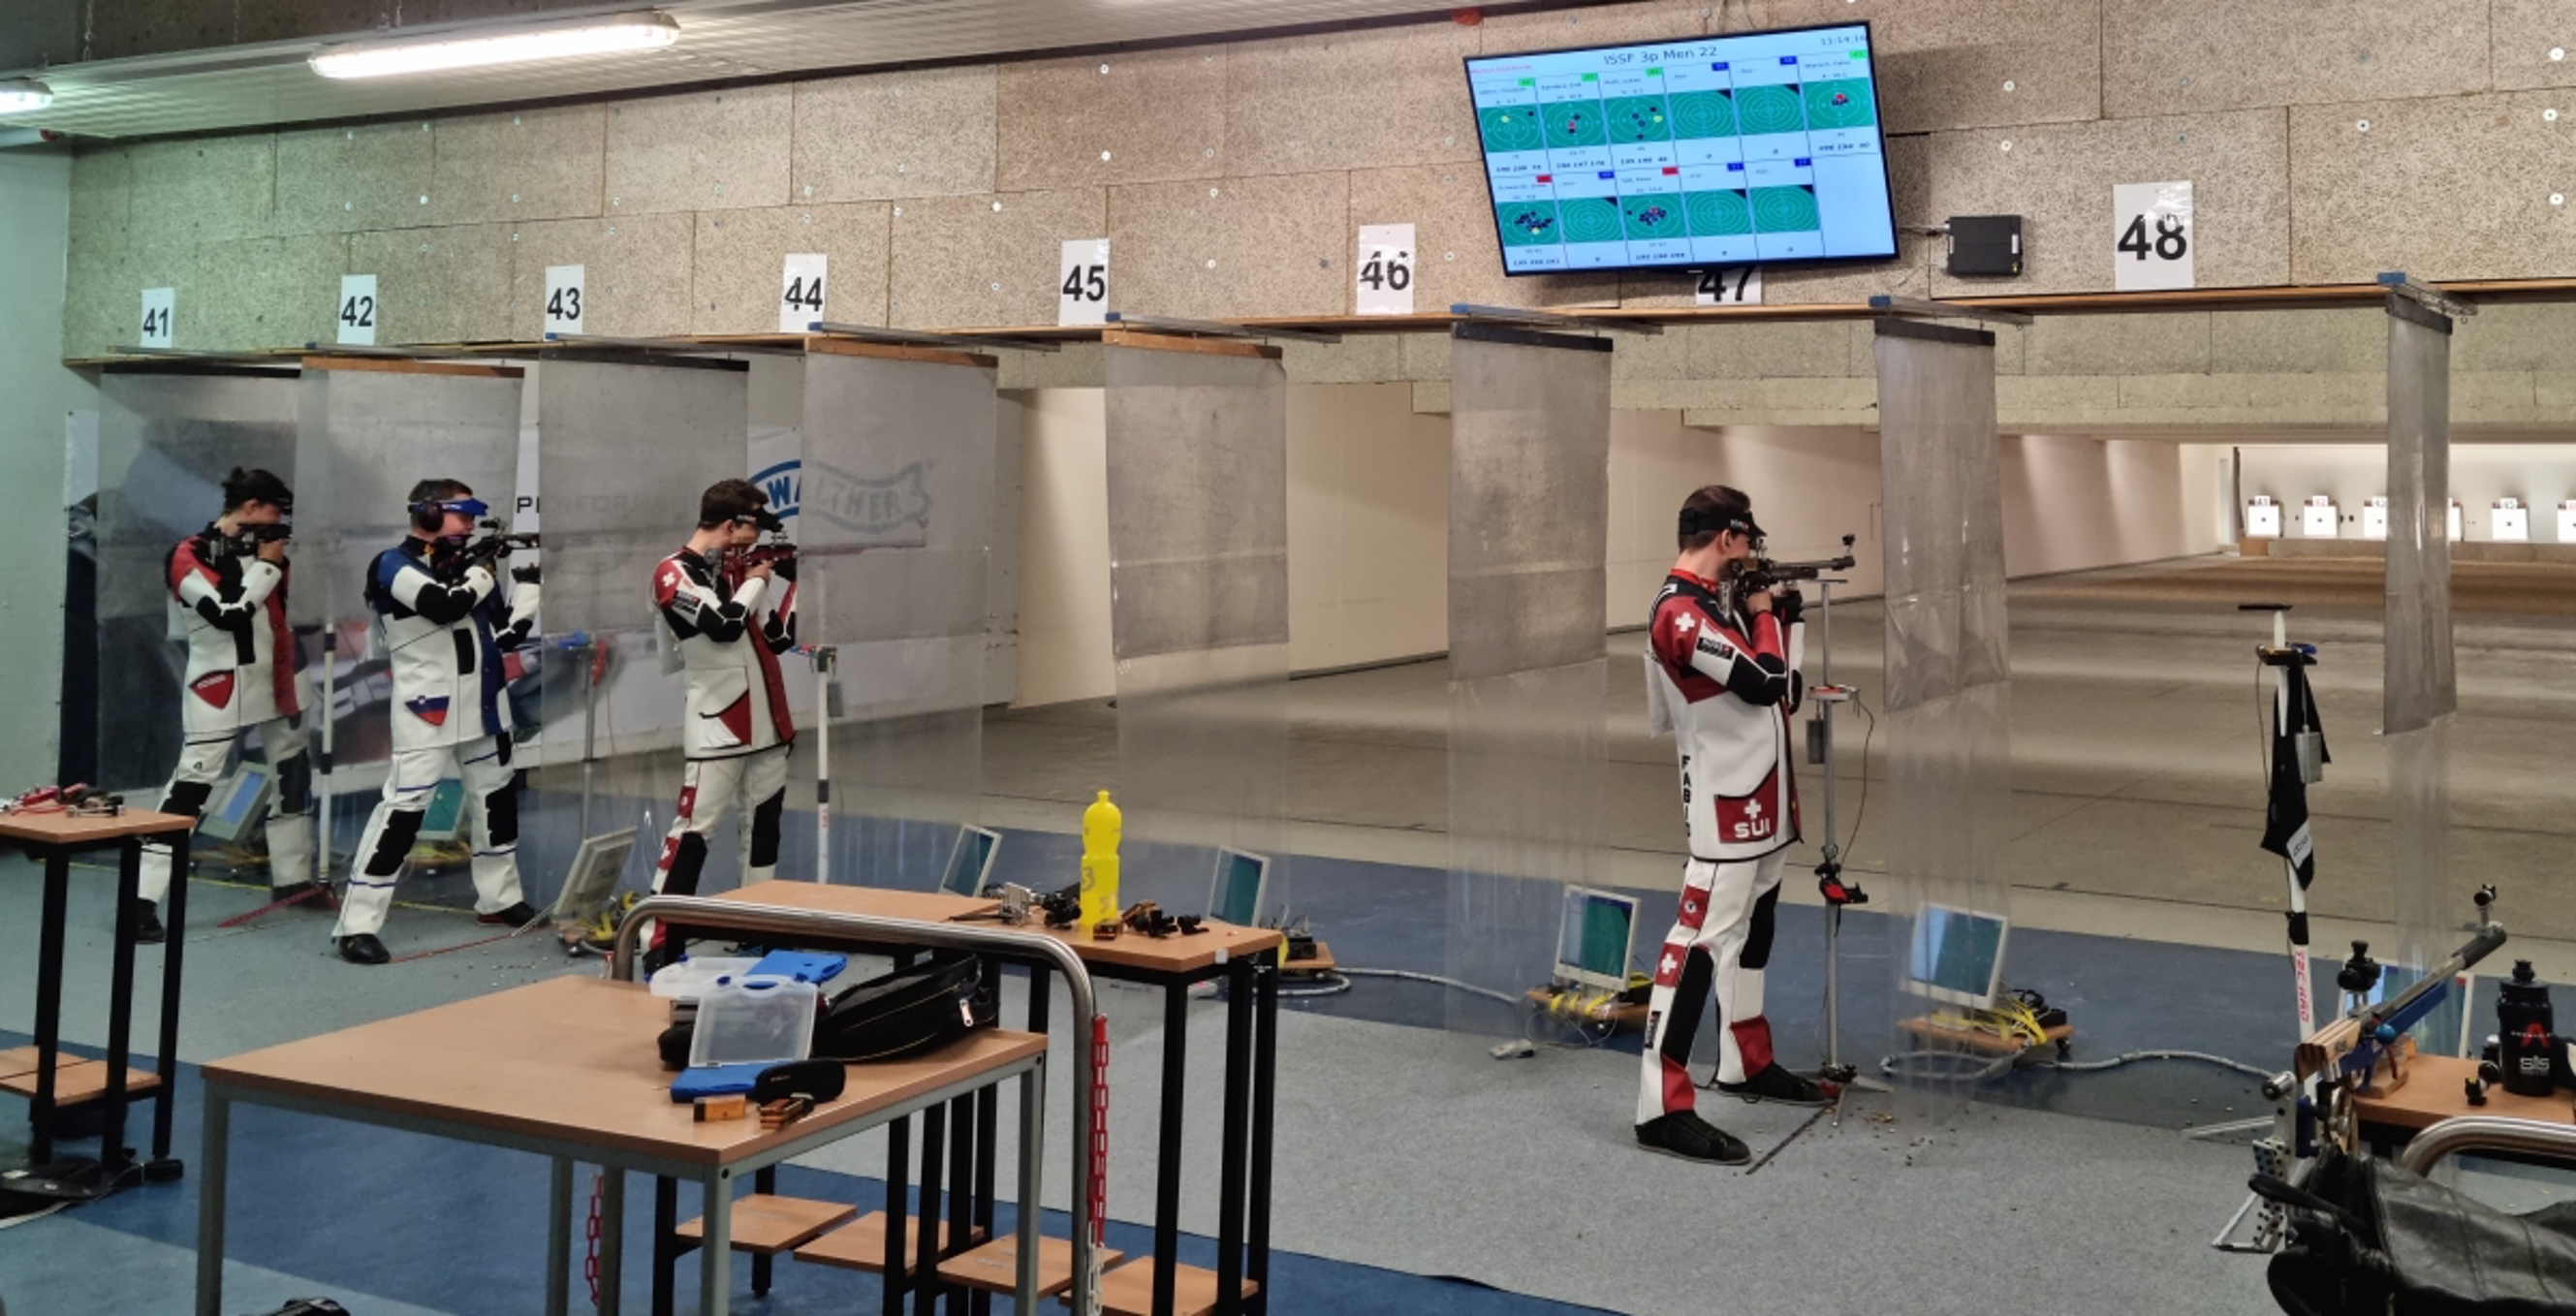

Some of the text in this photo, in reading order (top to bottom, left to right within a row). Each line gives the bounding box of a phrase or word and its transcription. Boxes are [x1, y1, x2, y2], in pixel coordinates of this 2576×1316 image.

[1604, 47, 1717, 65] ISSF 3p Men 22
[2118, 214, 2186, 261] 48
[1062, 264, 1106, 301] 45
[1359, 250, 1410, 291] 46
[1698, 266, 1755, 302] 47
[547, 287, 581, 320] 43
[784, 276, 823, 312] 44
[142, 307, 169, 337] 41
[341, 296, 373, 327] 42
[1734, 818, 1771, 838] SUI
